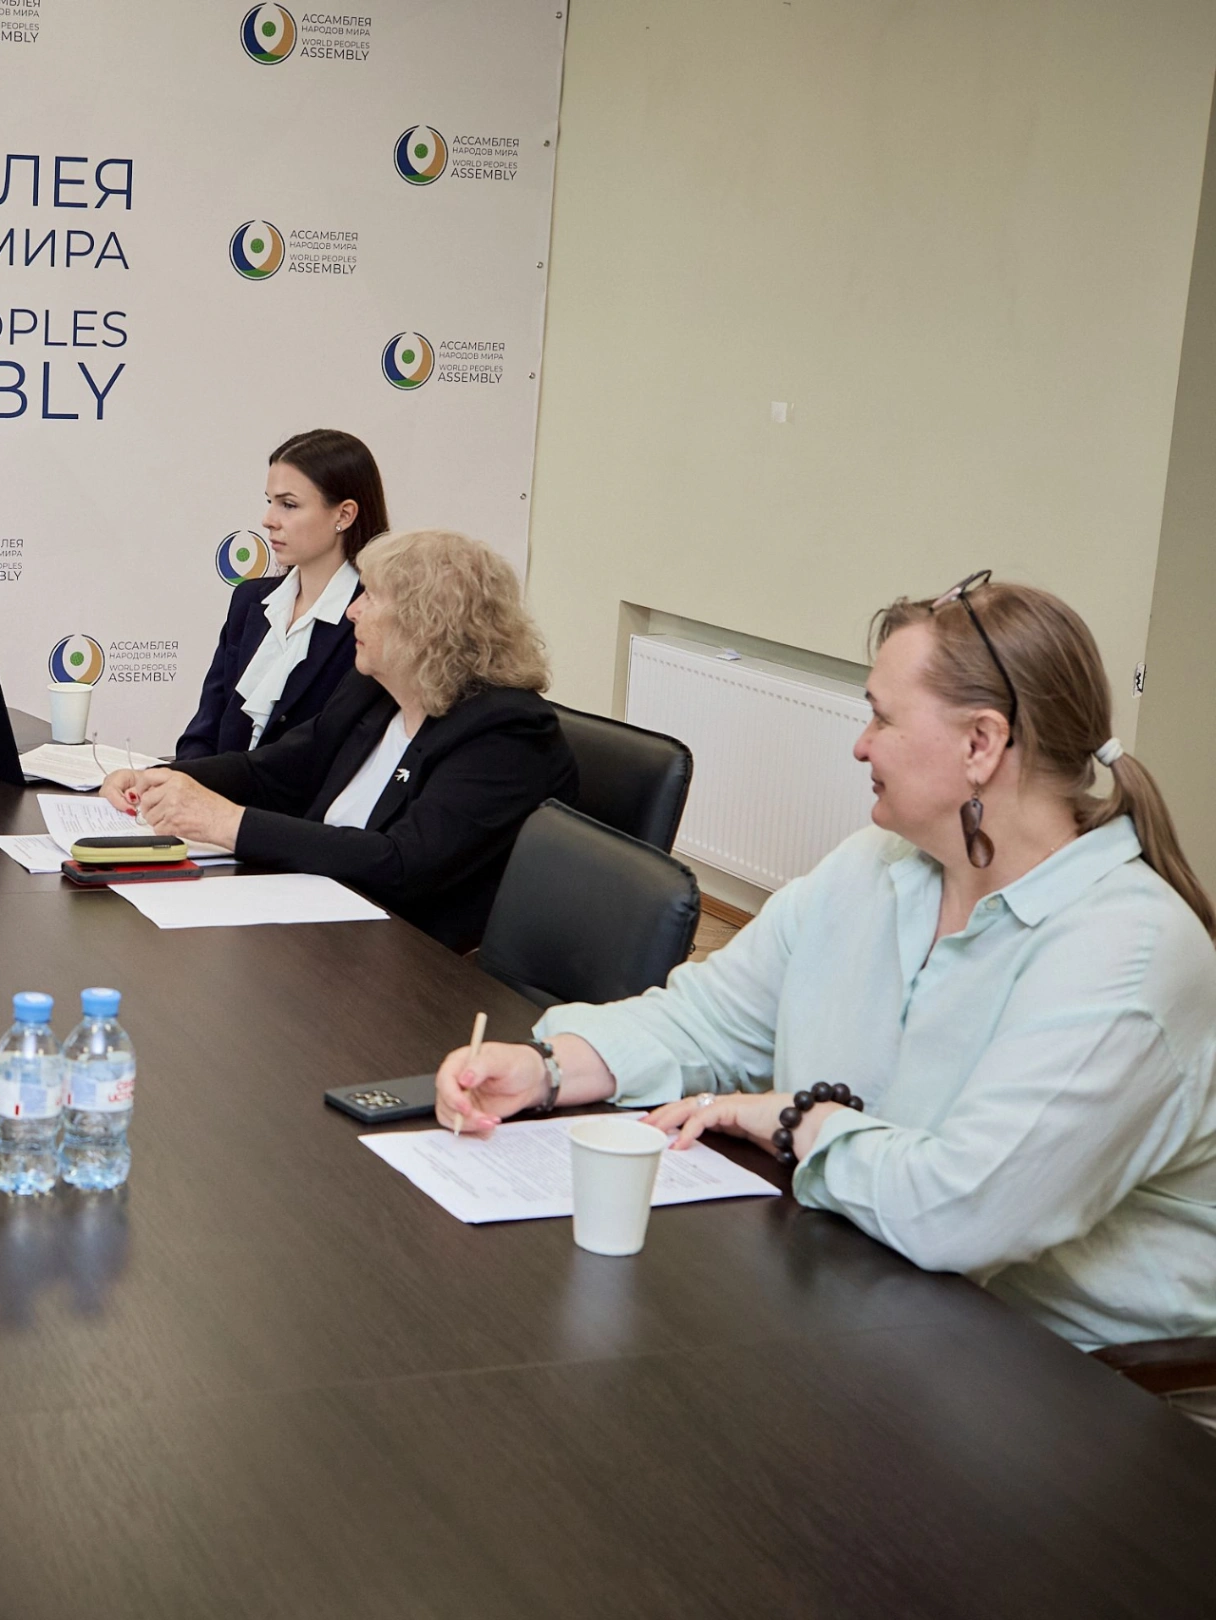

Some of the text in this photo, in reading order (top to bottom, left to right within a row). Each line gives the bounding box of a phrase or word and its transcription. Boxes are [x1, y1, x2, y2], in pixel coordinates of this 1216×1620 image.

[12, 8, 40, 18] МИРА
[0, 21, 40, 31] PEOPLES
[301, 14, 372, 27] АССАМБЛЕЯ
[301, 25, 371, 36] НАРОДОВ МИРА
[301, 38, 370, 49] WORLD PEOPLES
[299, 47, 370, 61] ASSEMBLY
[452, 135, 520, 148] АССАМБЛЕЯ
[452, 146, 519, 157] НАРОДОВ МИРА
[451, 159, 518, 170] WORLD PEOPLES
[450, 167, 518, 181] ASSEMBLY
[289, 229, 359, 242] АССАМБЛЕЯ
[289, 241, 358, 251] НАРОДОВ МИРА
[289, 253, 357, 264] WORLD PEOPLES
[287, 261, 357, 275] ASSEMBLY
[439, 340, 506, 352] АССАМБЛЕЯ
[438, 351, 504, 360] НАРОДОВ МИРА
[438, 363, 504, 373] WORLD PEOPLES
[437, 371, 503, 384] ASSEMBLY
[109, 640, 179, 651] АССАМБЛЕЯ
[109, 651, 178, 661] НАРОДОВ МИРА
[109, 663, 178, 672] WORLD PEOPLES
[107, 671, 177, 683] ASSEMBLY
